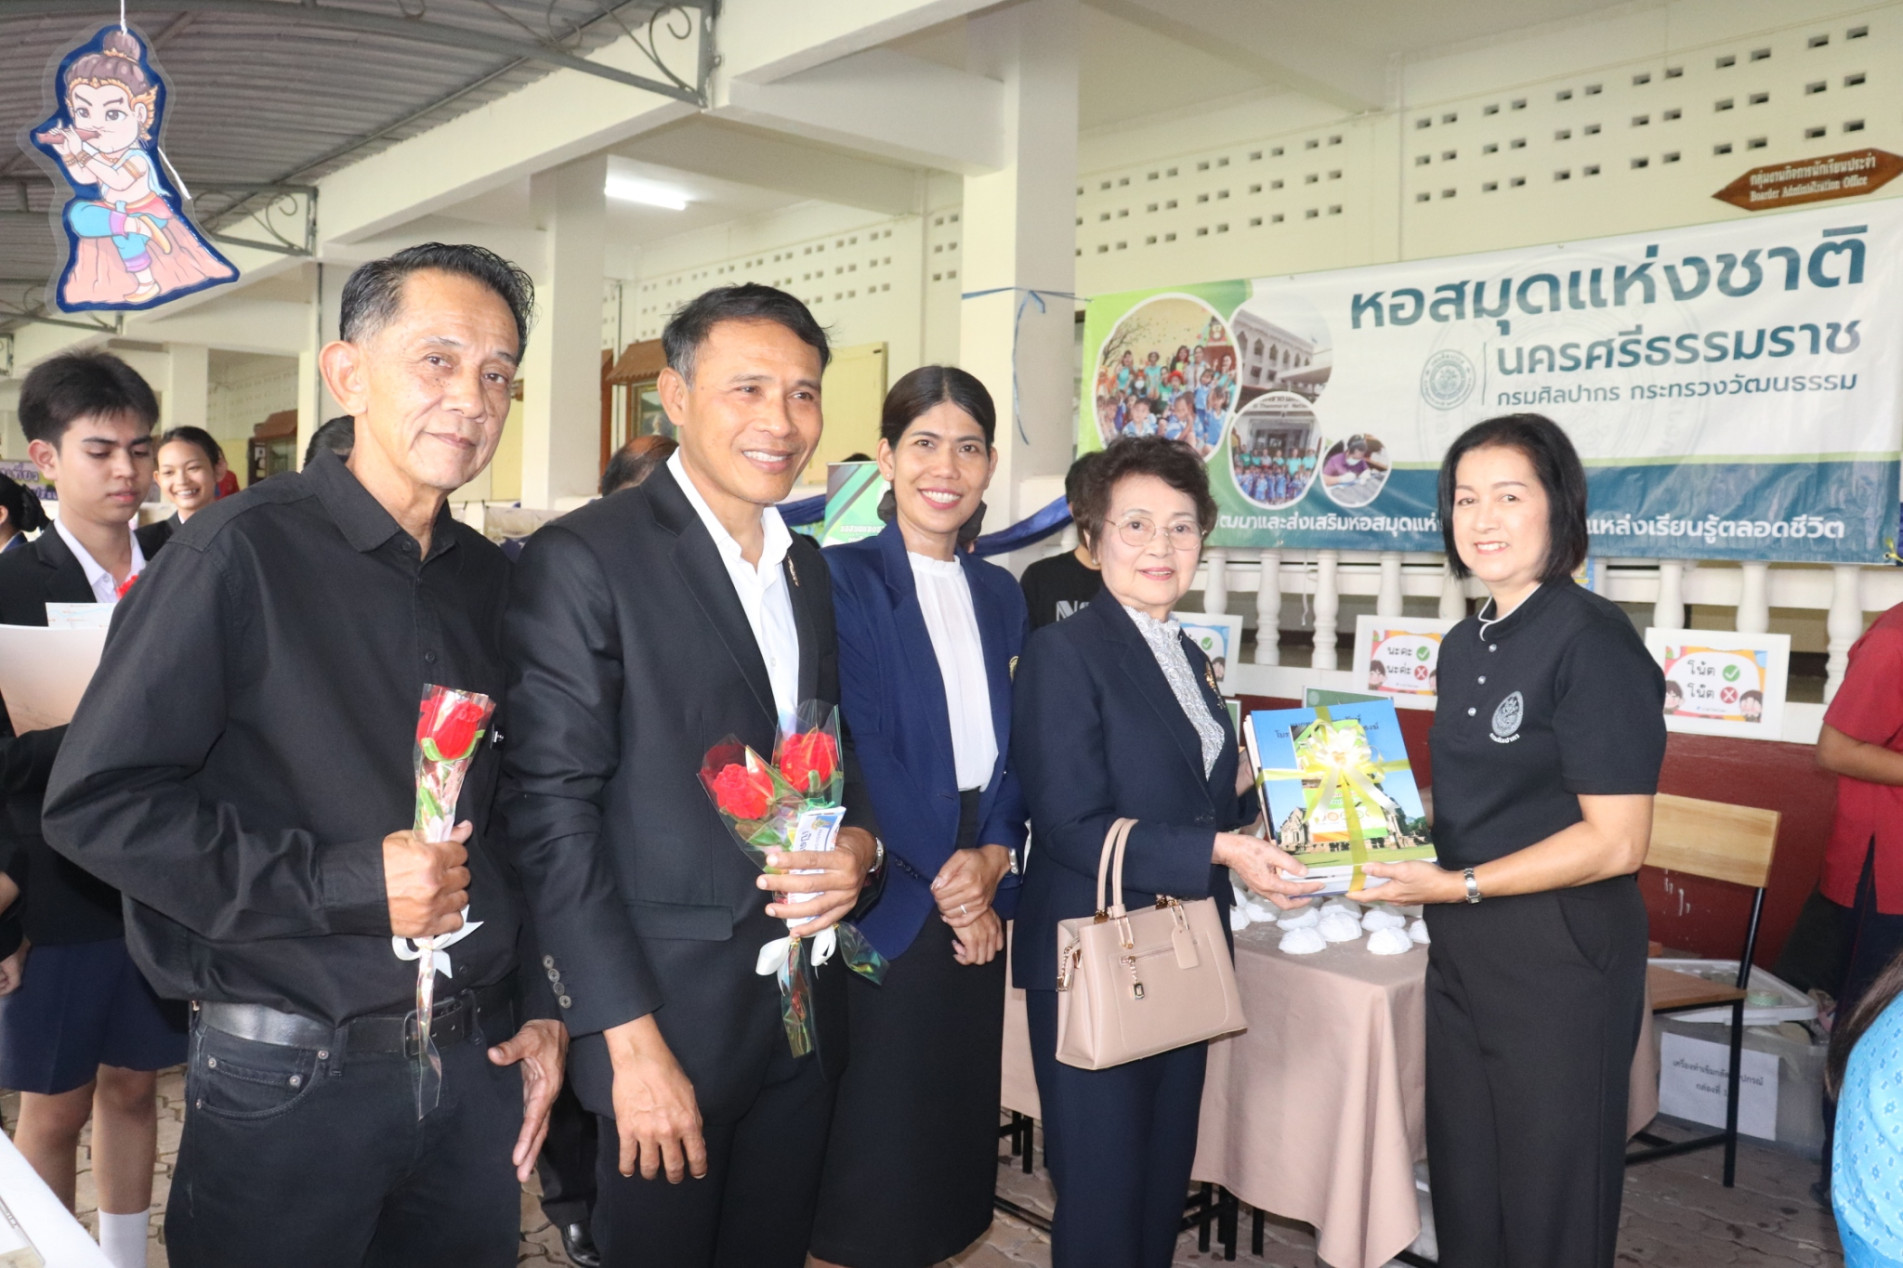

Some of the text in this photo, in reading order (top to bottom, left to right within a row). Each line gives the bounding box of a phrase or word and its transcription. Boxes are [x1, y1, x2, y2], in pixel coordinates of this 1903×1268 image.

[1750, 175, 1868, 202] Boarder Administration Office
[1351, 225, 1868, 336] หอสมุดแห่งชาติ
[1497, 319, 1861, 376] นครศรีธรรมราช
[1497, 372, 1857, 406] กรมศิลปากร กระทรวงวัฒนธรรม
[1216, 511, 1845, 544] ฒนาและส่งเสริมหอสมุดแห่ แหล่งเรียนรู้ตลอดชีวิต
